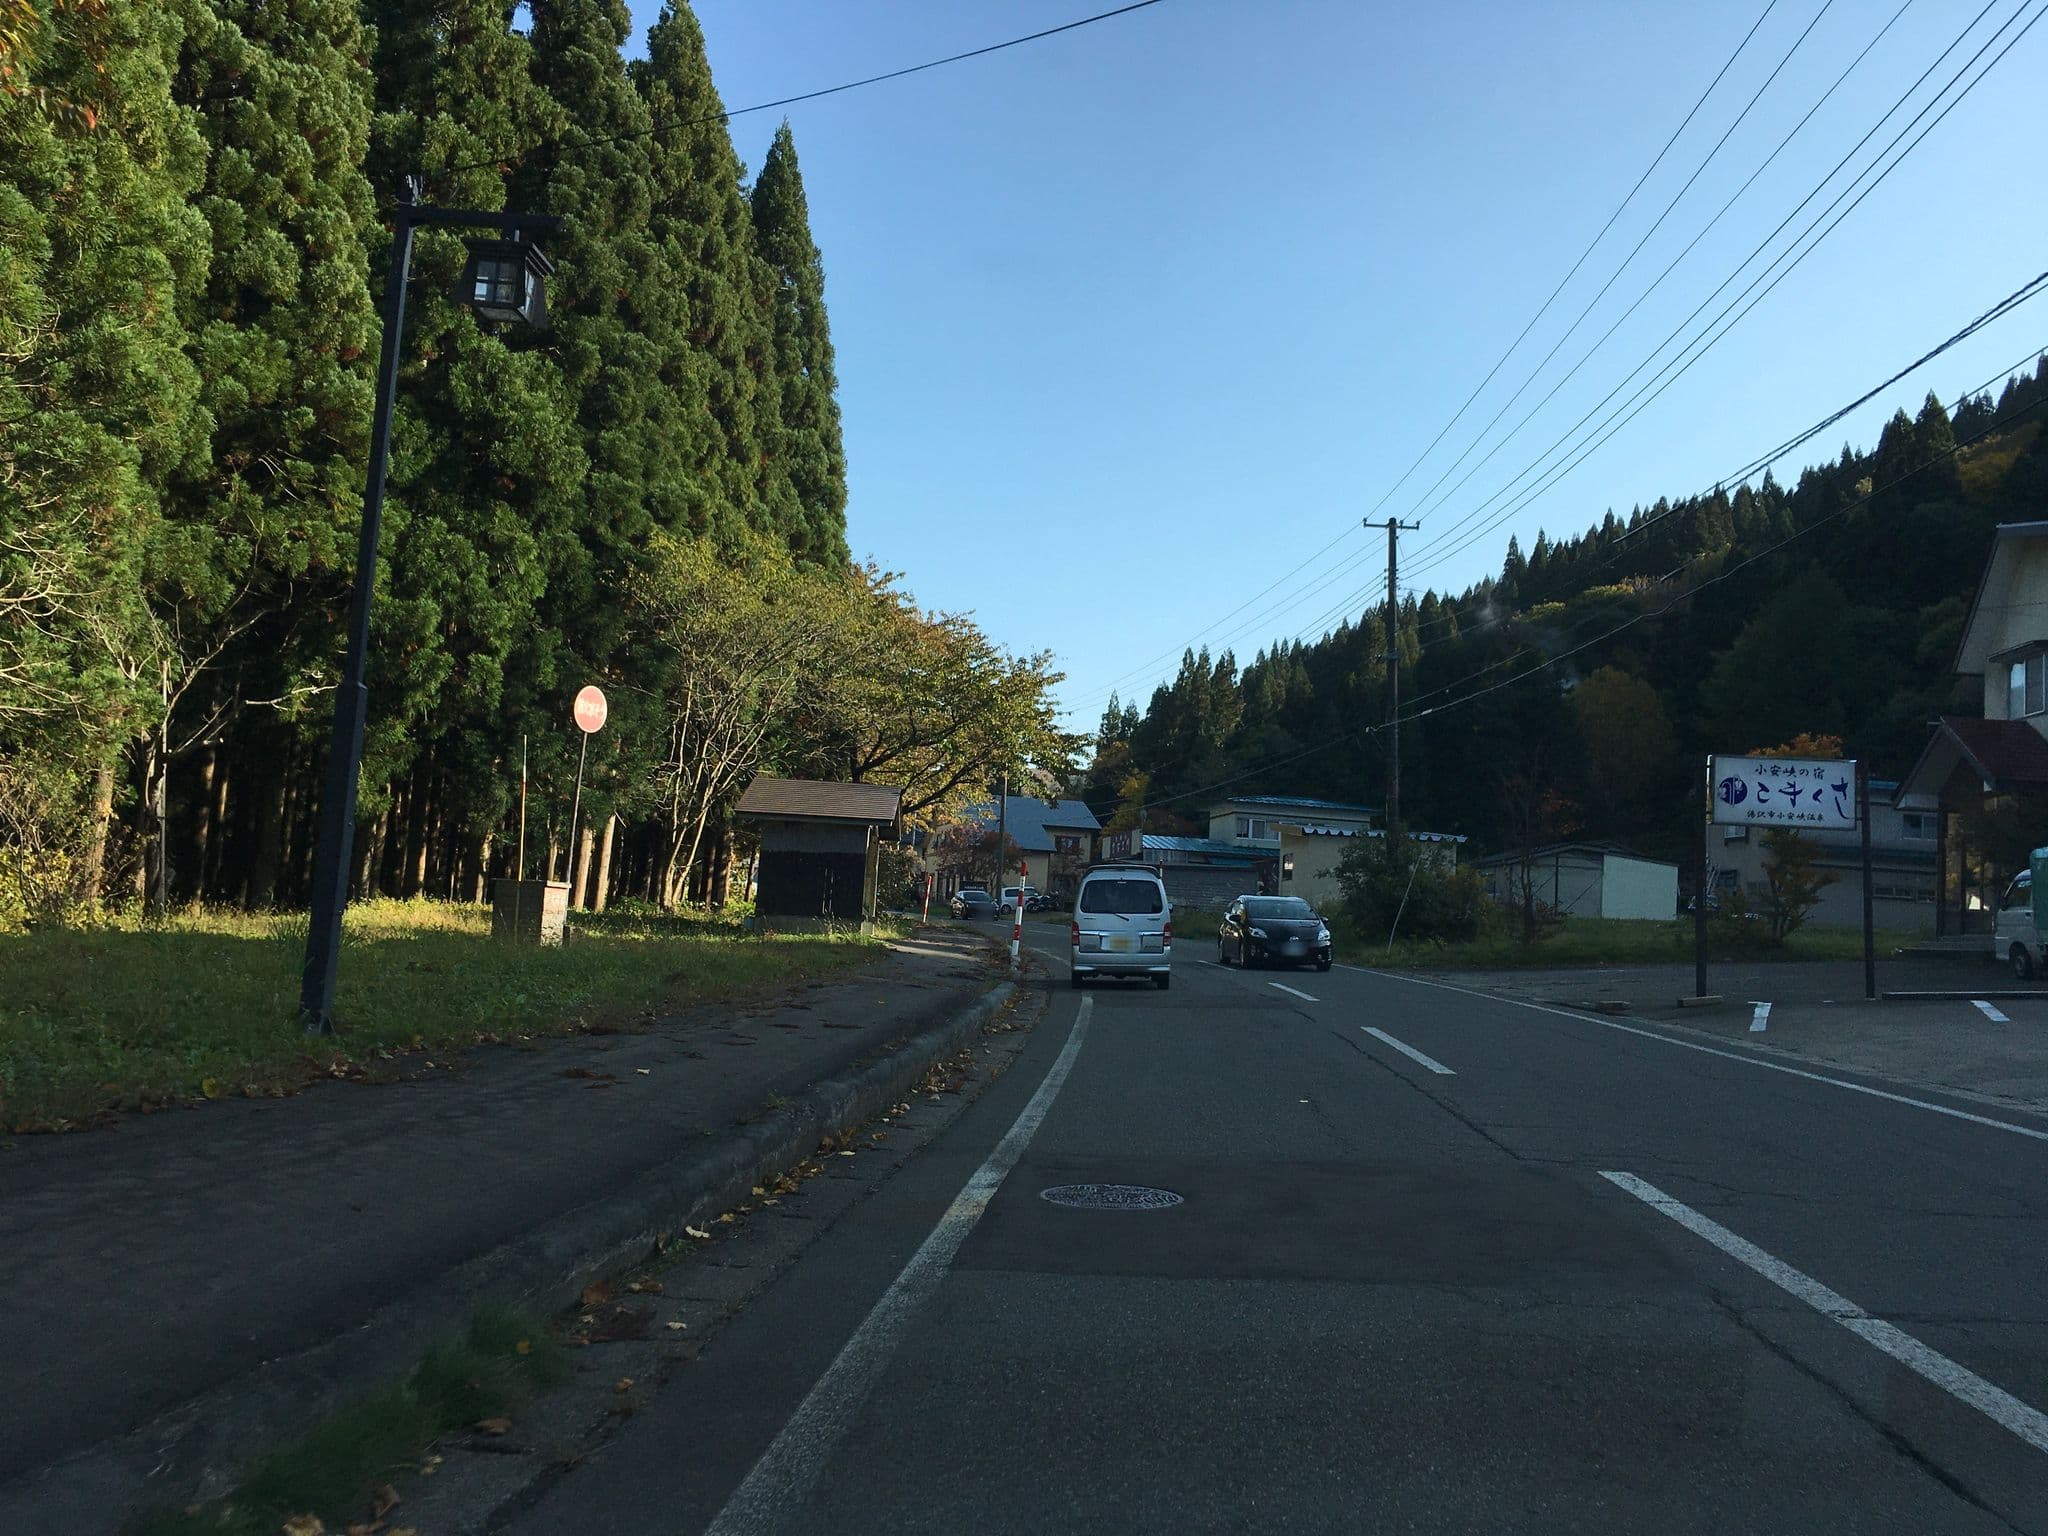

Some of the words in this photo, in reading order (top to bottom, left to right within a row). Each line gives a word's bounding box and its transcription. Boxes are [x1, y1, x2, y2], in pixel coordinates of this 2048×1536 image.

[1755, 764, 1825, 780] 小安峡の宿
